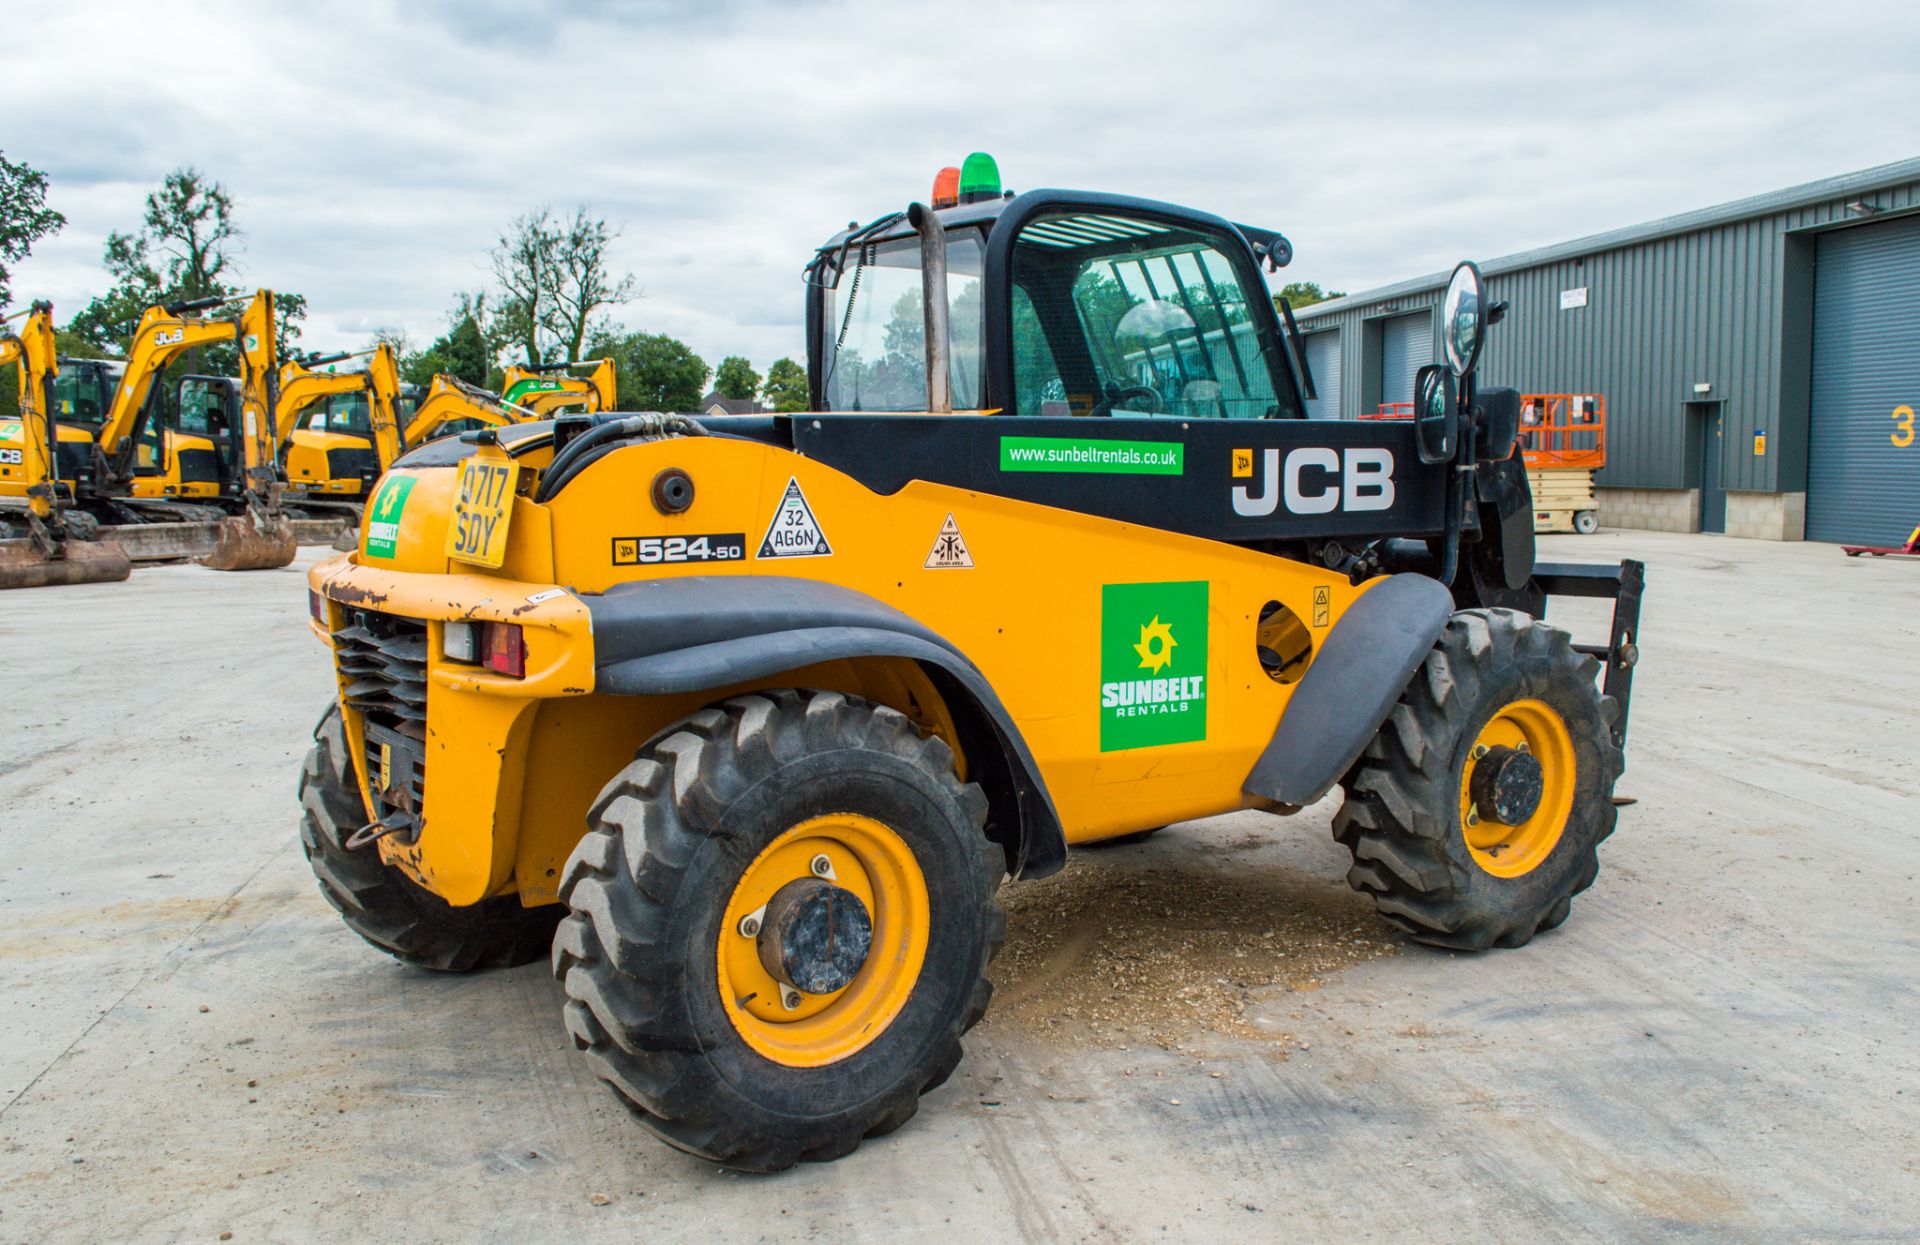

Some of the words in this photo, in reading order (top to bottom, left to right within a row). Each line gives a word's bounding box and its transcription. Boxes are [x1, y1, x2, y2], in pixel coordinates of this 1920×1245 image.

[1891, 405, 1915, 447] 3
[1009, 446, 1177, 465] www.sunbeltrentals.co.uk
[1232, 447, 1395, 517] JCB
[785, 509, 804, 527] 32
[455, 511, 497, 556] SDY
[774, 529, 814, 547] AG6N
[638, 537, 741, 562] 524-50
[1101, 675, 1204, 708] SUNBELT
[1116, 702, 1189, 717] RENTALS
